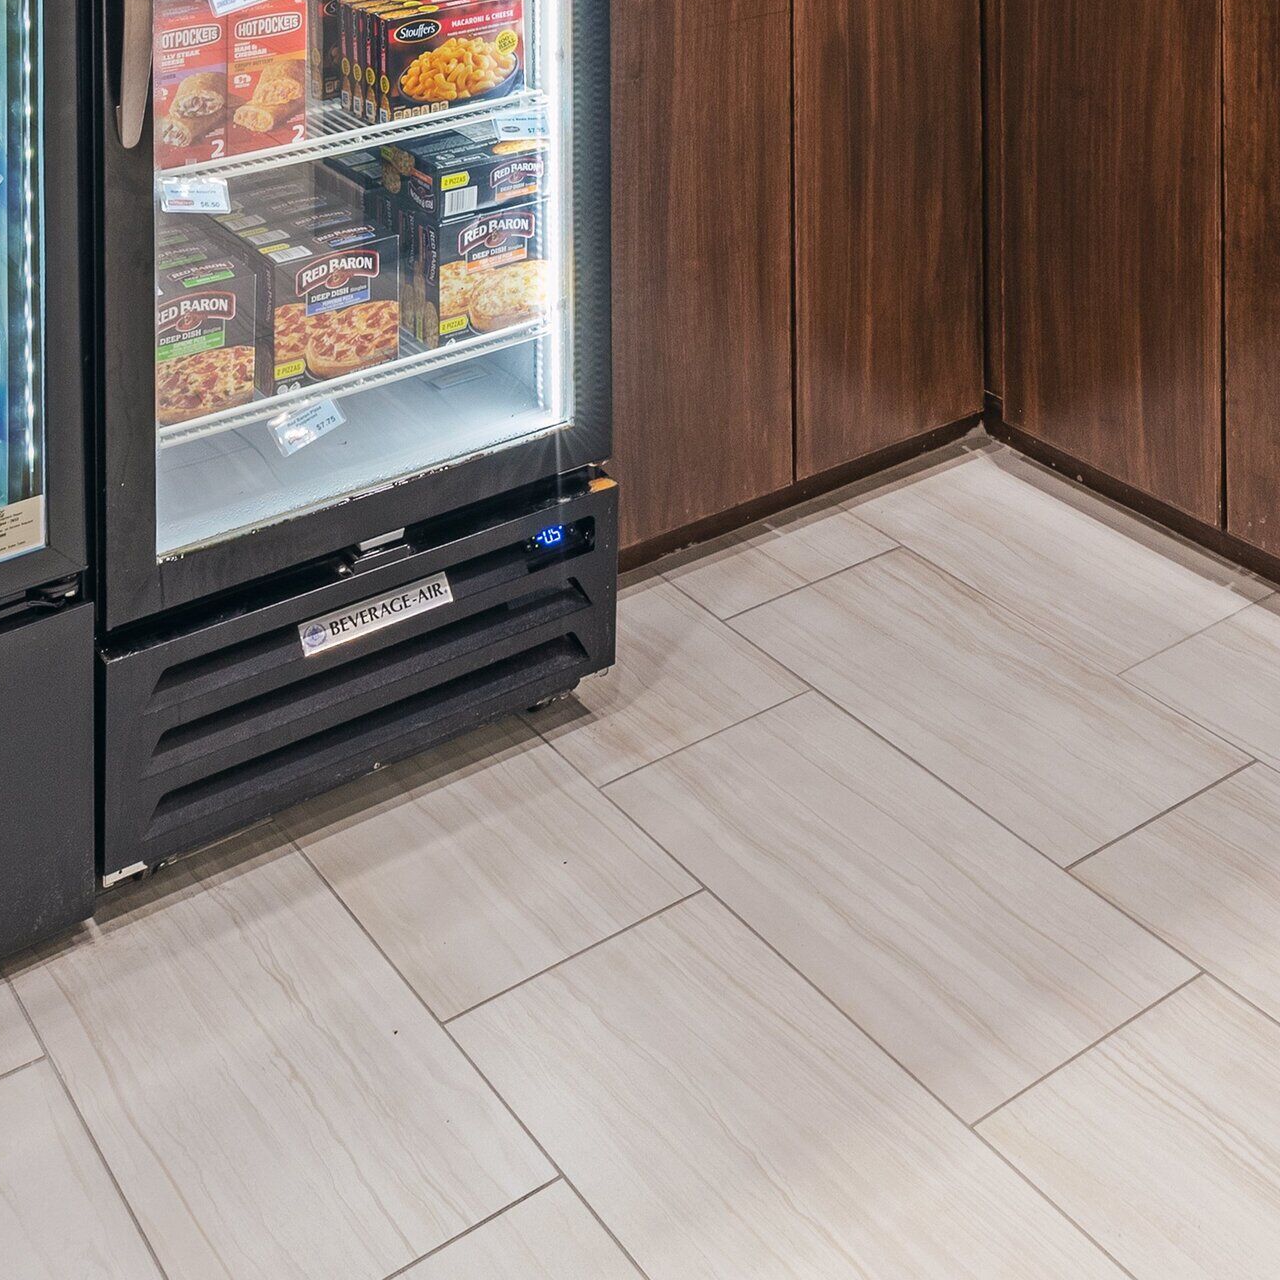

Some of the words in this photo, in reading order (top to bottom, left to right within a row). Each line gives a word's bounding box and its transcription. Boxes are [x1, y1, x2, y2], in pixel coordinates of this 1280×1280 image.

[238, 20, 258, 38] HOT
[258, 13, 300, 36] POCKETS
[451, 17, 482, 27] MACARONI
[490, 9, 514, 21] CHEESE
[398, 21, 438, 41] Stouffer's
[292, 124, 304, 143] 2
[210, 138, 224, 158] 2
[494, 166, 510, 181] RED
[511, 160, 541, 174] BARON
[463, 227, 489, 244] RED
[489, 216, 529, 239] BARON
[471, 252, 489, 261] DEEP
[490, 248, 507, 257] DISH
[302, 266, 330, 287] RED
[330, 256, 374, 278] BARON
[310, 293, 330, 304] DEEP
[331, 287, 349, 298] DISH
[186, 297, 228, 318] BARON
[447, 318, 467, 330] PIZZAS
[159, 333, 179, 345] DEEP
[180, 328, 202, 340] DISH
[277, 367, 283, 375] 2
[283, 362, 303, 375] PIZZAS
[330, 582, 444, 636] BEVERAGE-AIR
